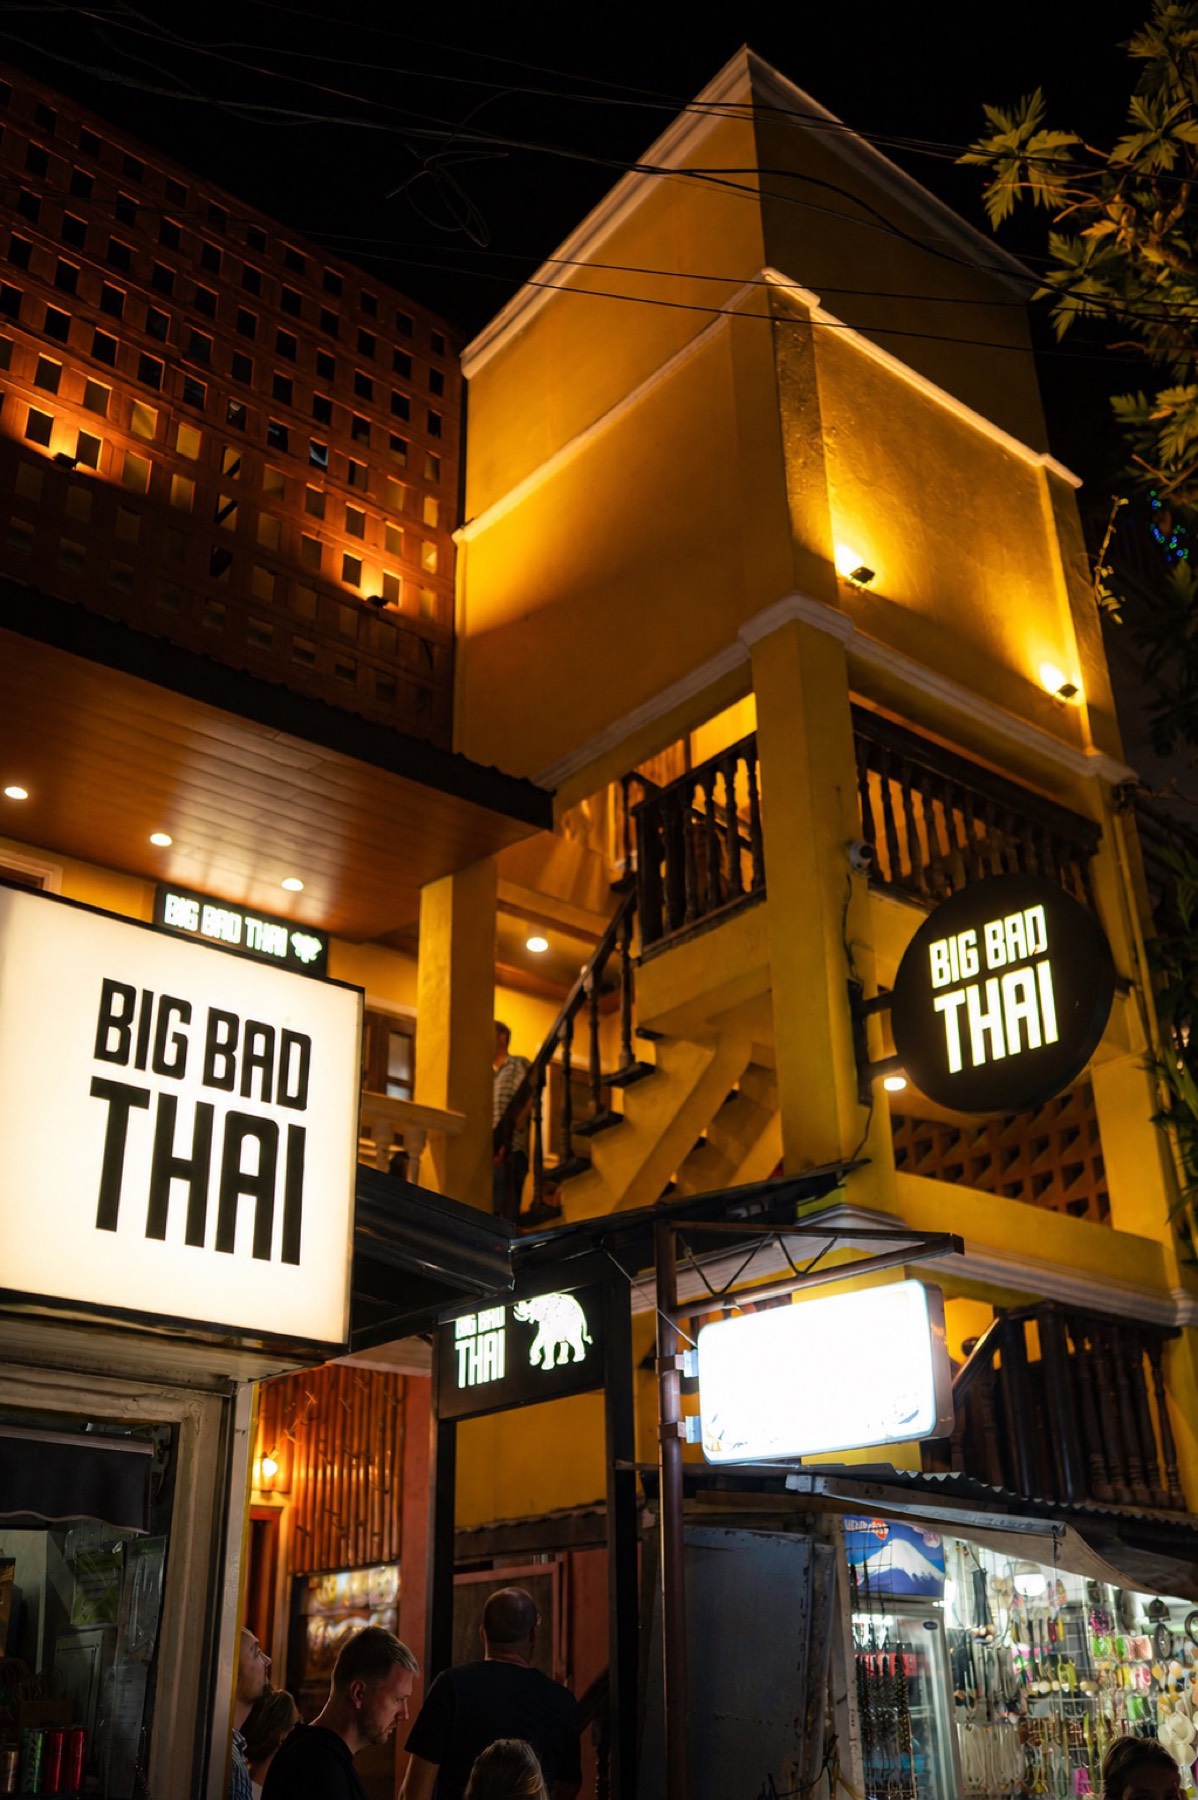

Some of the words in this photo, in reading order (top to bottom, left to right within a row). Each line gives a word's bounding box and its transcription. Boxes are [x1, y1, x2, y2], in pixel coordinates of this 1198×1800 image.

[164, 893, 199, 932] BIG
[201, 904, 242, 944] BAD
[245, 916, 288, 957] THAI
[929, 928, 980, 989] BIG
[984, 904, 1048, 971] BAD
[93, 977, 192, 1081] BIG
[202, 1006, 312, 1112] BAD
[933, 959, 1059, 1074] THAI
[89, 1075, 307, 1266] THAI
[455, 1329, 505, 1388] THAI
